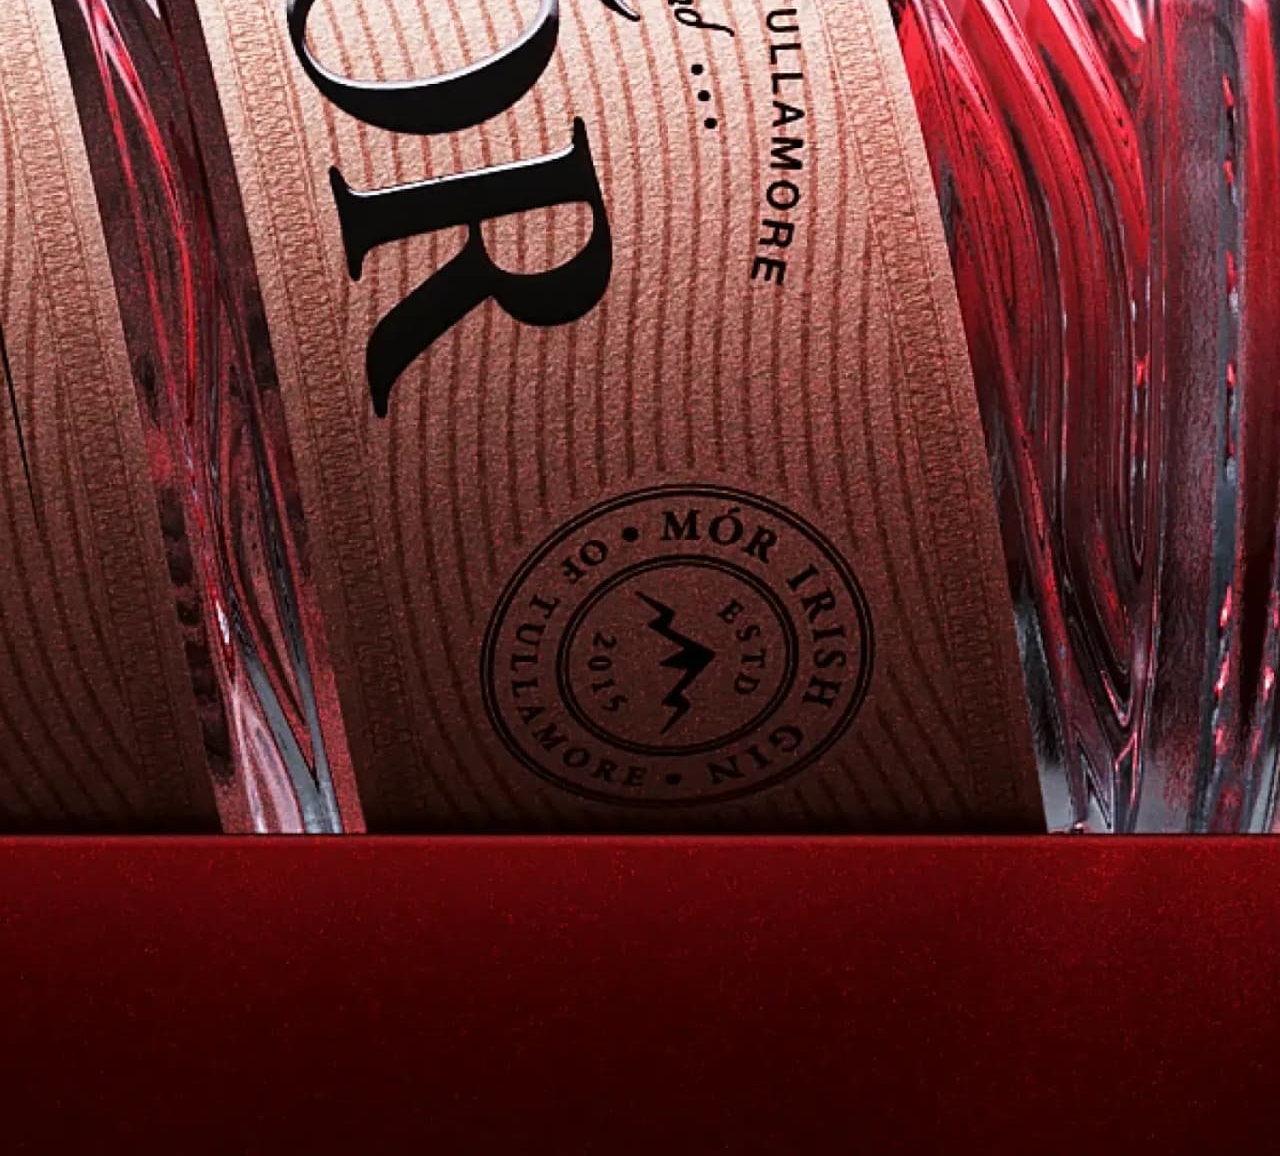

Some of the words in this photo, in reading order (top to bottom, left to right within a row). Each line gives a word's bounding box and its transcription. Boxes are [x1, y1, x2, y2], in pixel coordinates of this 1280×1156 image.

[562, 539, 609, 586] OF
[661, 507, 779, 564] MÓR
[587, 631, 629, 714] 2015
[716, 598, 767, 697] ESTD
[786, 563, 848, 710] IRISH
[510, 594, 649, 788] TULLAMORE
[707, 724, 805, 786] GIN
